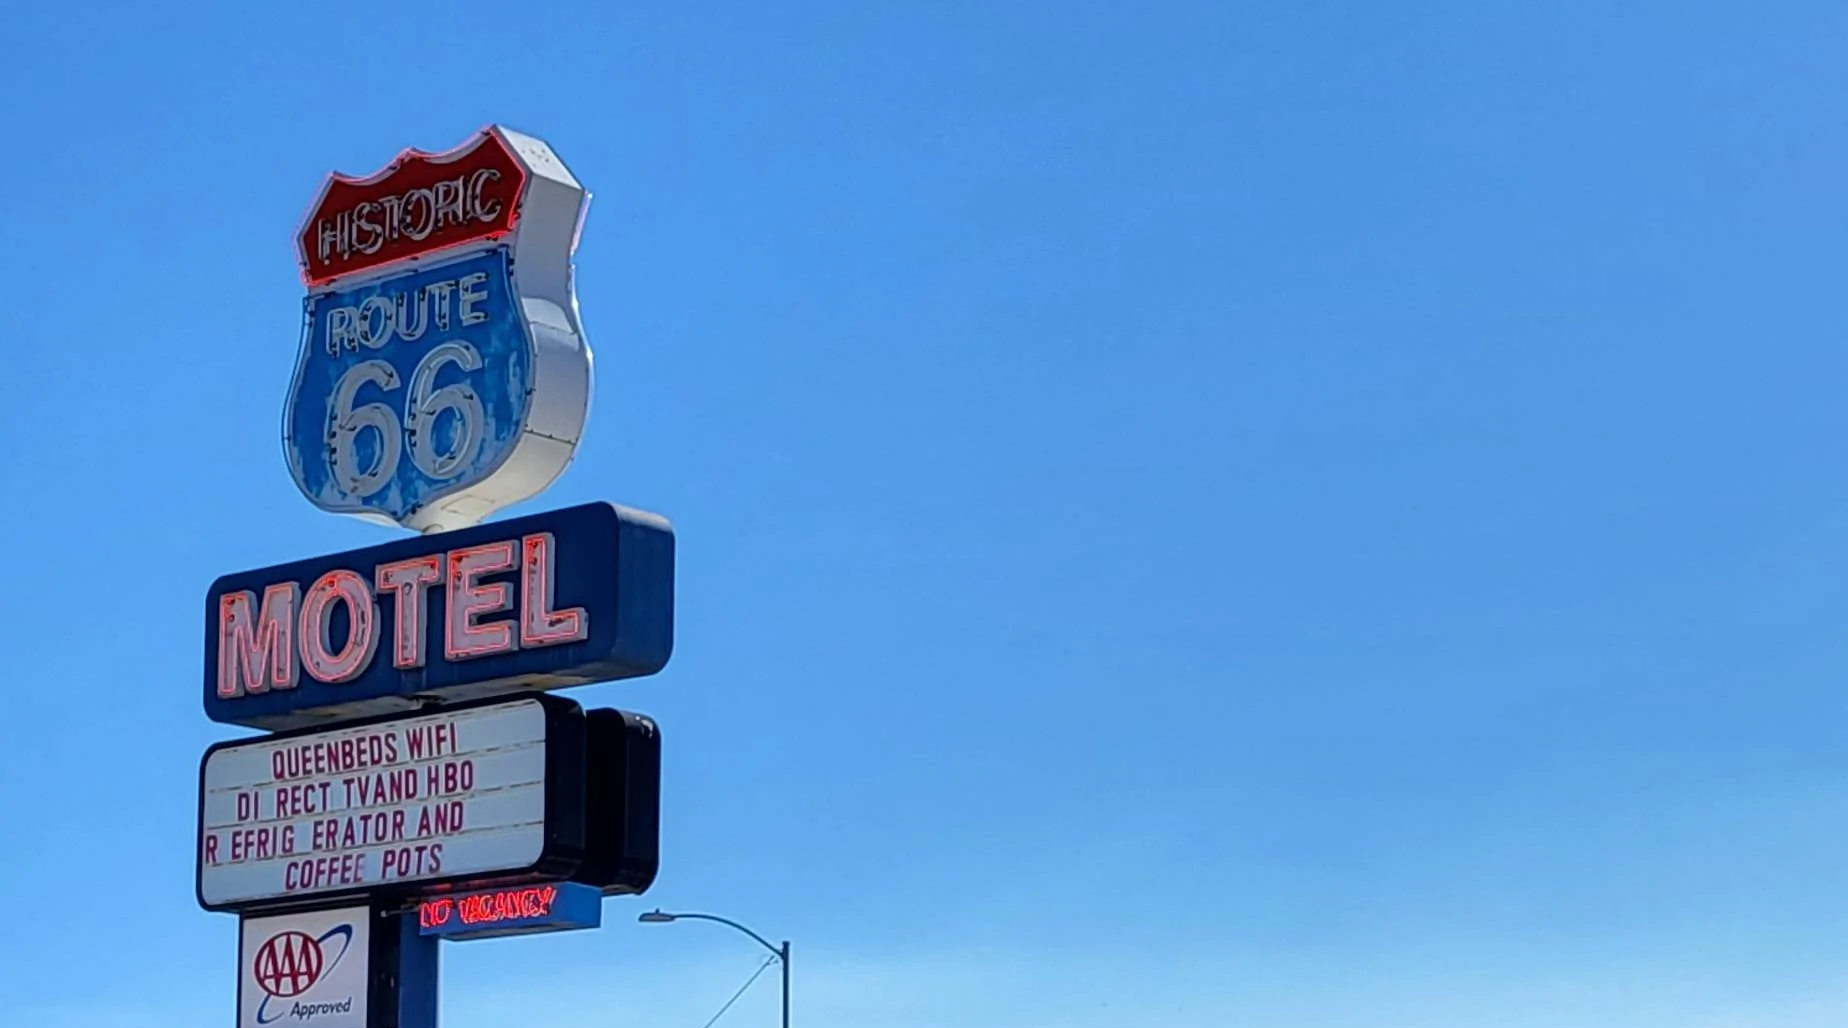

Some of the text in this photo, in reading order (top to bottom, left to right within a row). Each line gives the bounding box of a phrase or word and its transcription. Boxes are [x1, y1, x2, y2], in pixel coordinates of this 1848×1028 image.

[317, 168, 501, 266] HISTORIC
[326, 272, 489, 359] ROUTE
[324, 340, 484, 498] 66
[217, 532, 588, 698] MOTEL
[406, 722, 457, 761] WIFI
[427, 760, 474, 794] HBO
[418, 801, 464, 835] AND
[285, 844, 443, 891] COFFEE POTS
[418, 887, 556, 928] NO VACANCY
[255, 931, 323, 997] AAA
[290, 997, 352, 1021] Approved
